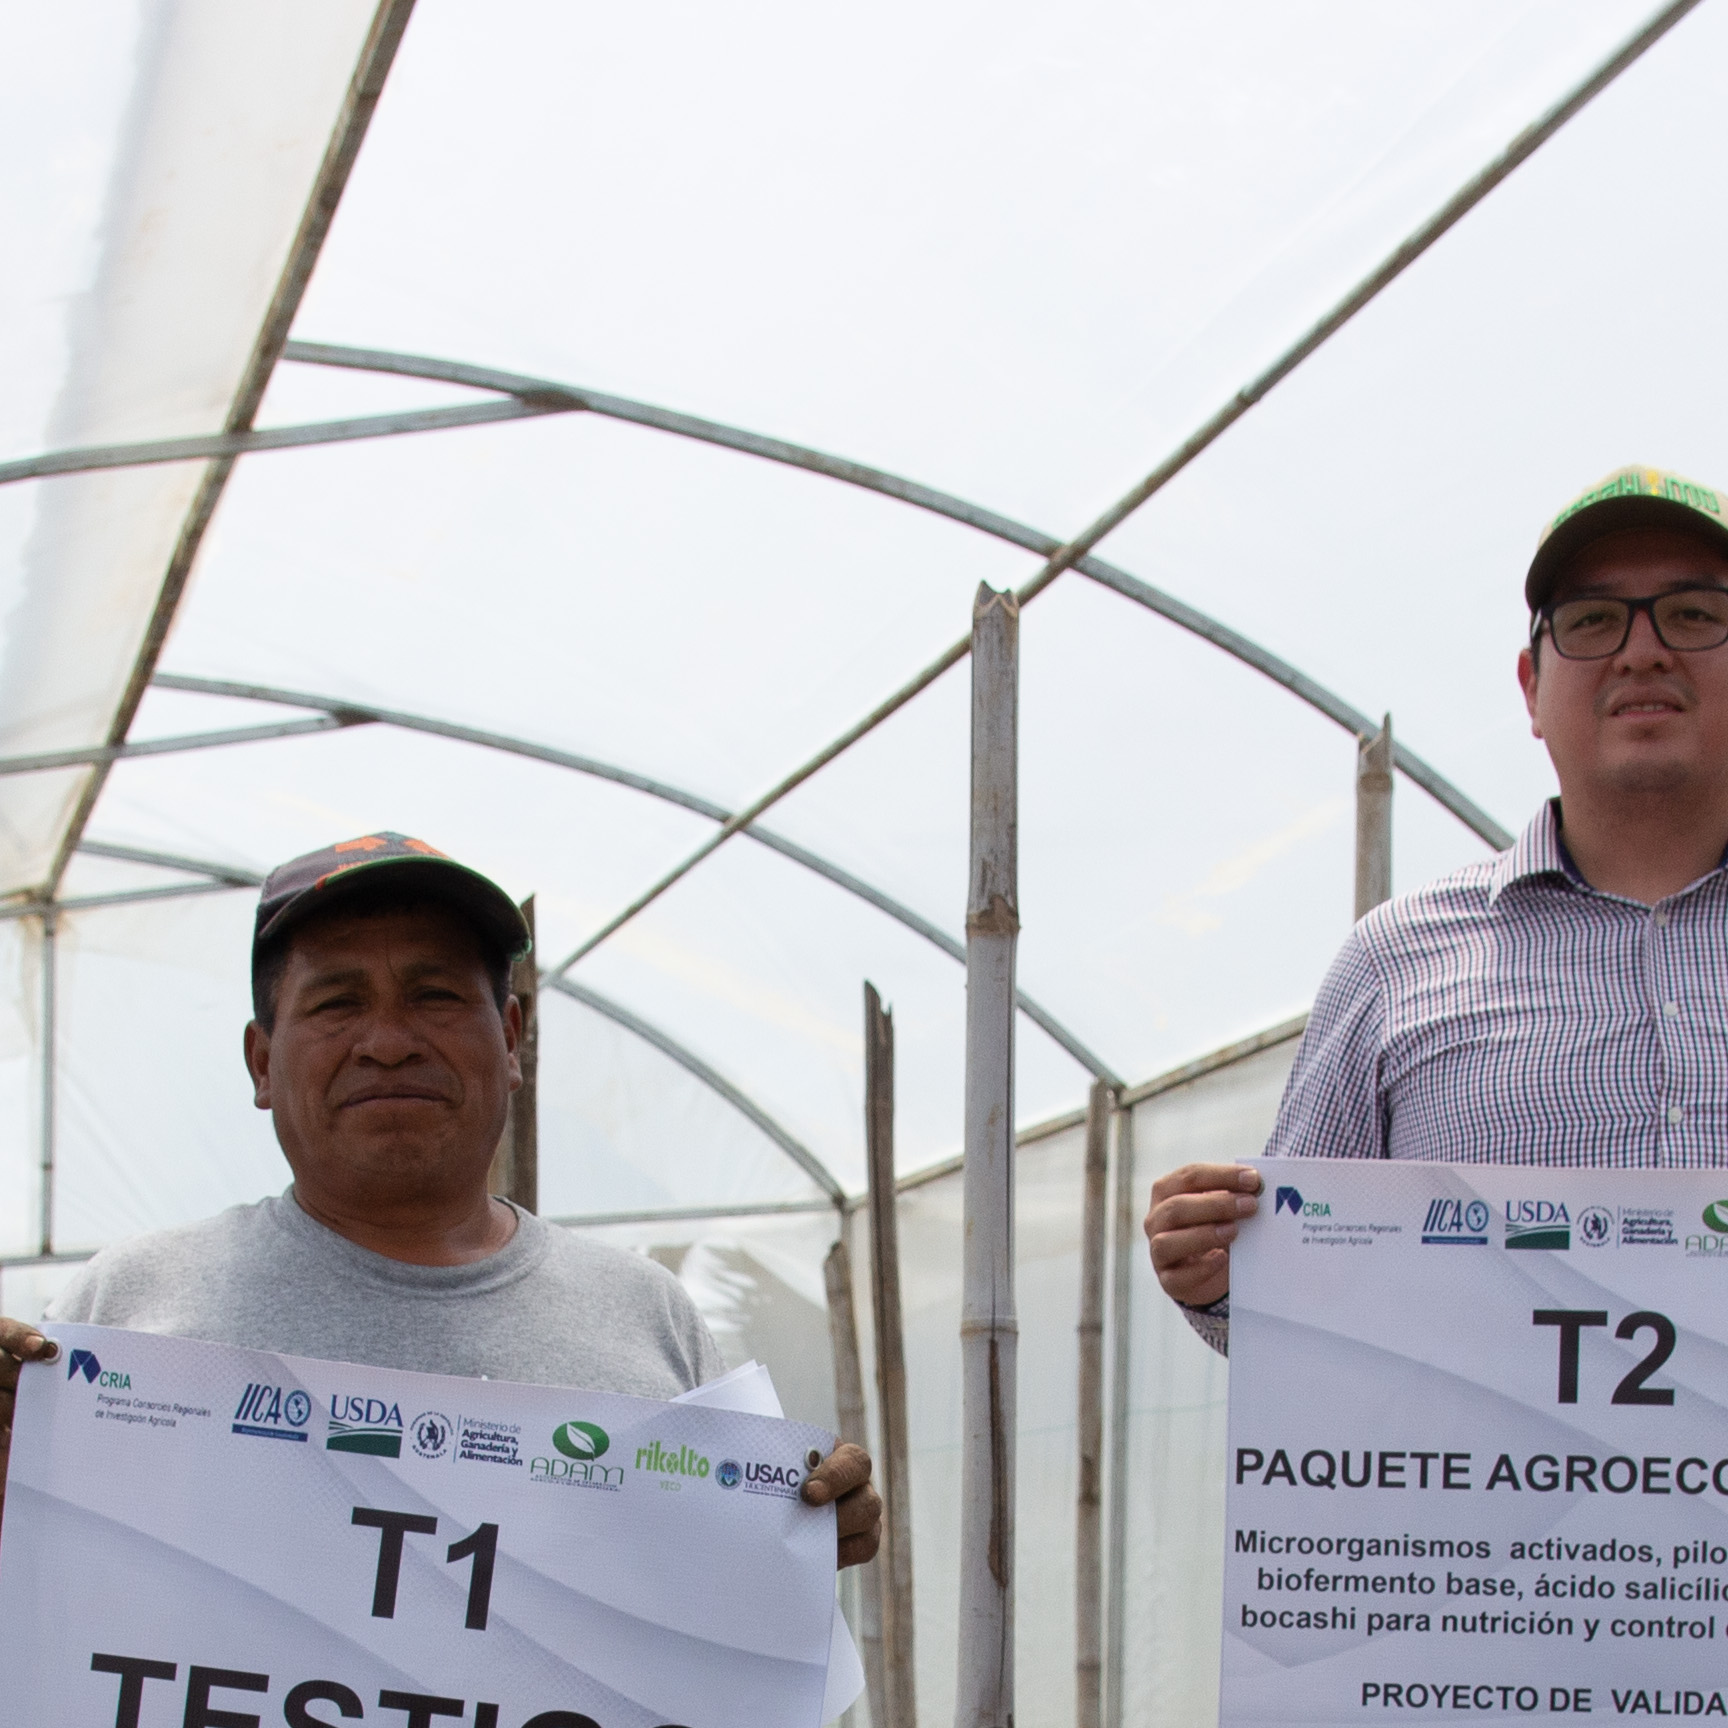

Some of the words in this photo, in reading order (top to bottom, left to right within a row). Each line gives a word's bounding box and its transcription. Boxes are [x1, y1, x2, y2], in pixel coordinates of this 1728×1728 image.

[1303, 1203, 1332, 1217] CRIA
[1422, 1198, 1463, 1233] IICA
[1505, 1200, 1571, 1223] USDA
[1622, 1217, 1673, 1227] Agricultura,
[1532, 1309, 1677, 1406] T2
[99, 1371, 132, 1390] CRIA
[234, 1382, 281, 1425] IICA
[330, 1394, 404, 1428] USDA
[462, 1429, 520, 1446] Agricultura,
[463, 1417, 508, 1432] Ministerio
[509, 1423, 522, 1434] de
[459, 1449, 523, 1466] Alimentación
[460, 1439, 511, 1454] Ganadería
[511, 1446, 519, 1458] y
[635, 1440, 711, 1478] rikolto
[530, 1456, 625, 1485] ADAM
[745, 1461, 800, 1488] USAC
[1235, 1448, 1472, 1491] PAQUETE
[1235, 1529, 1491, 1562] Microorganismos
[1510, 1537, 1662, 1568] activados,
[351, 1506, 500, 1632] T1
[1258, 1567, 1435, 1595] biofermento
[1446, 1572, 1524, 1601] base,
[1535, 1573, 1615, 1599] ácido
[1241, 1604, 1355, 1631] bocashi
[1367, 1613, 1430, 1637] para
[1442, 1611, 1573, 1636] nutrición
[1584, 1619, 1600, 1642] y
[1611, 1616, 1714, 1640] control
[1362, 1683, 1538, 1712] PROYECTO
[1549, 1687, 1592, 1713] DE
